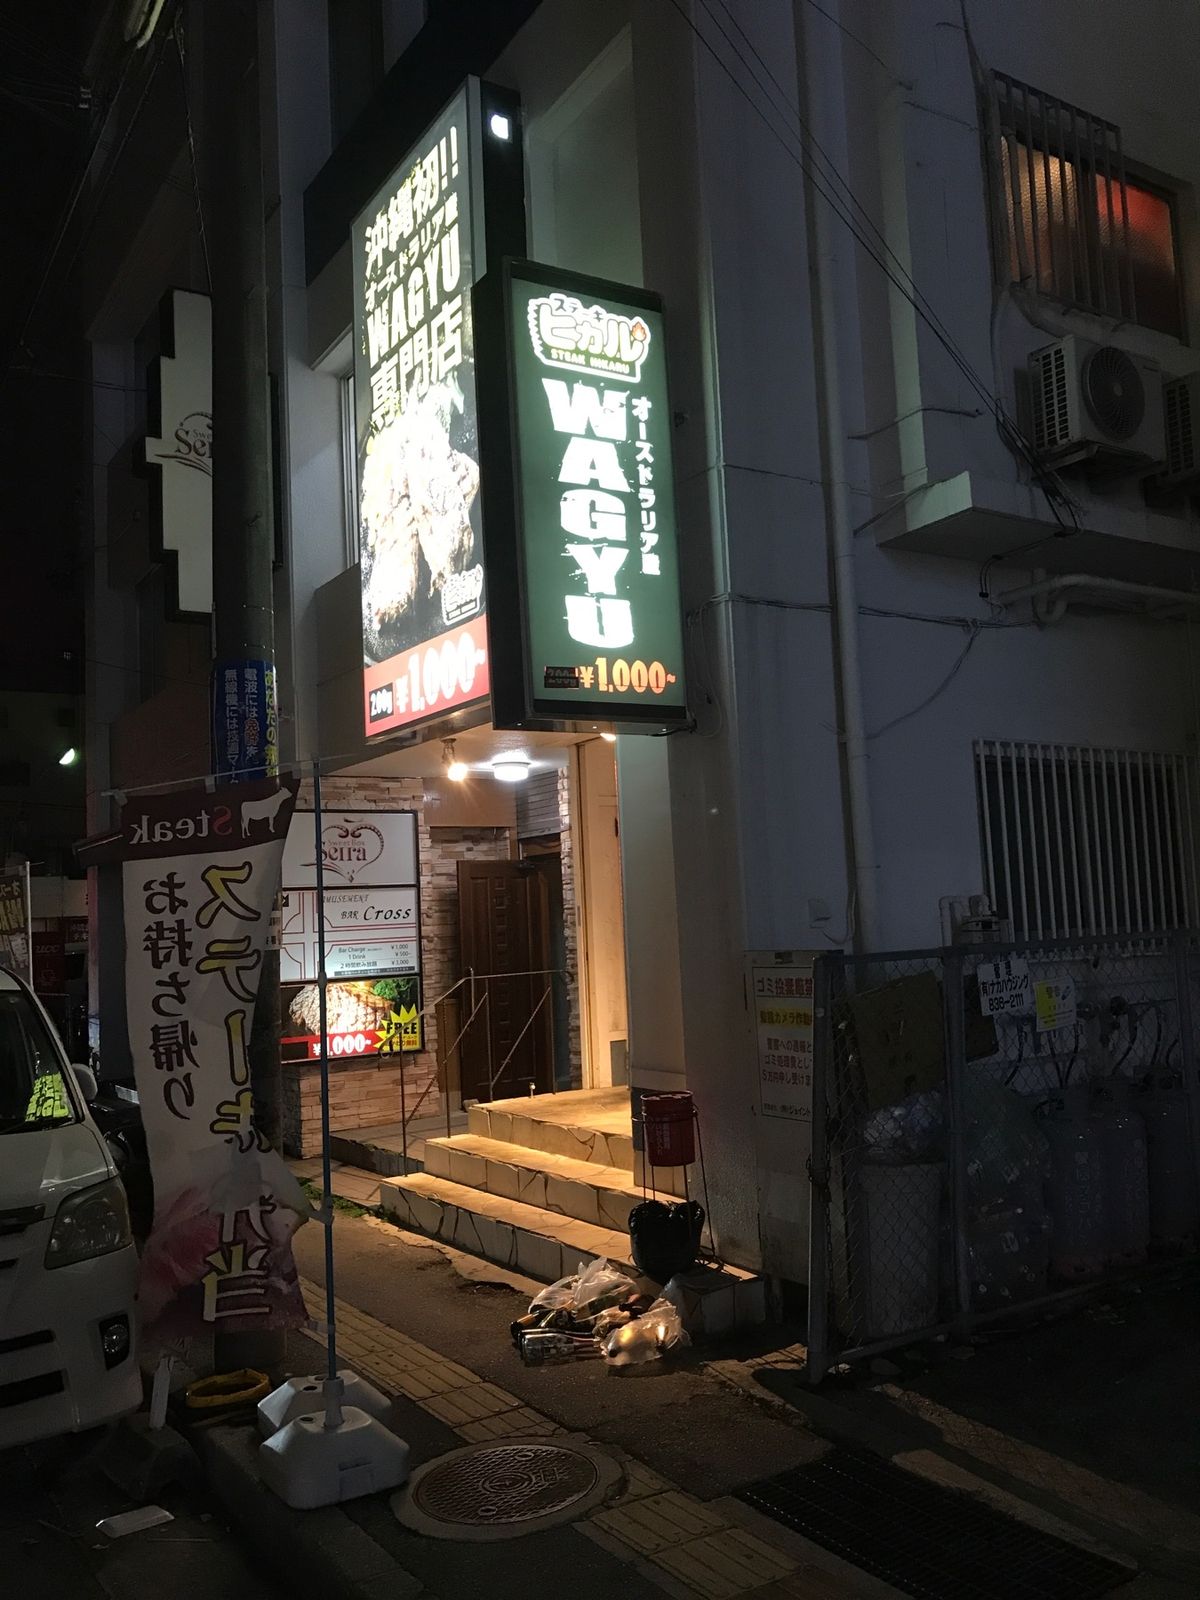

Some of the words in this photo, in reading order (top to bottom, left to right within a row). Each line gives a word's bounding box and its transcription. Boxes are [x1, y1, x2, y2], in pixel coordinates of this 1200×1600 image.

[367, 223, 460, 368] WAGYU
[540, 303, 645, 362] ヒカル
[551, 349, 586, 365] STEAK
[371, 295, 462, 430] 専門店
[542, 378, 635, 649] WAGYU
[341, 910, 359, 920] BAR
[363, 906, 412, 921] Cross
[387, 1022, 417, 1034] FREE
